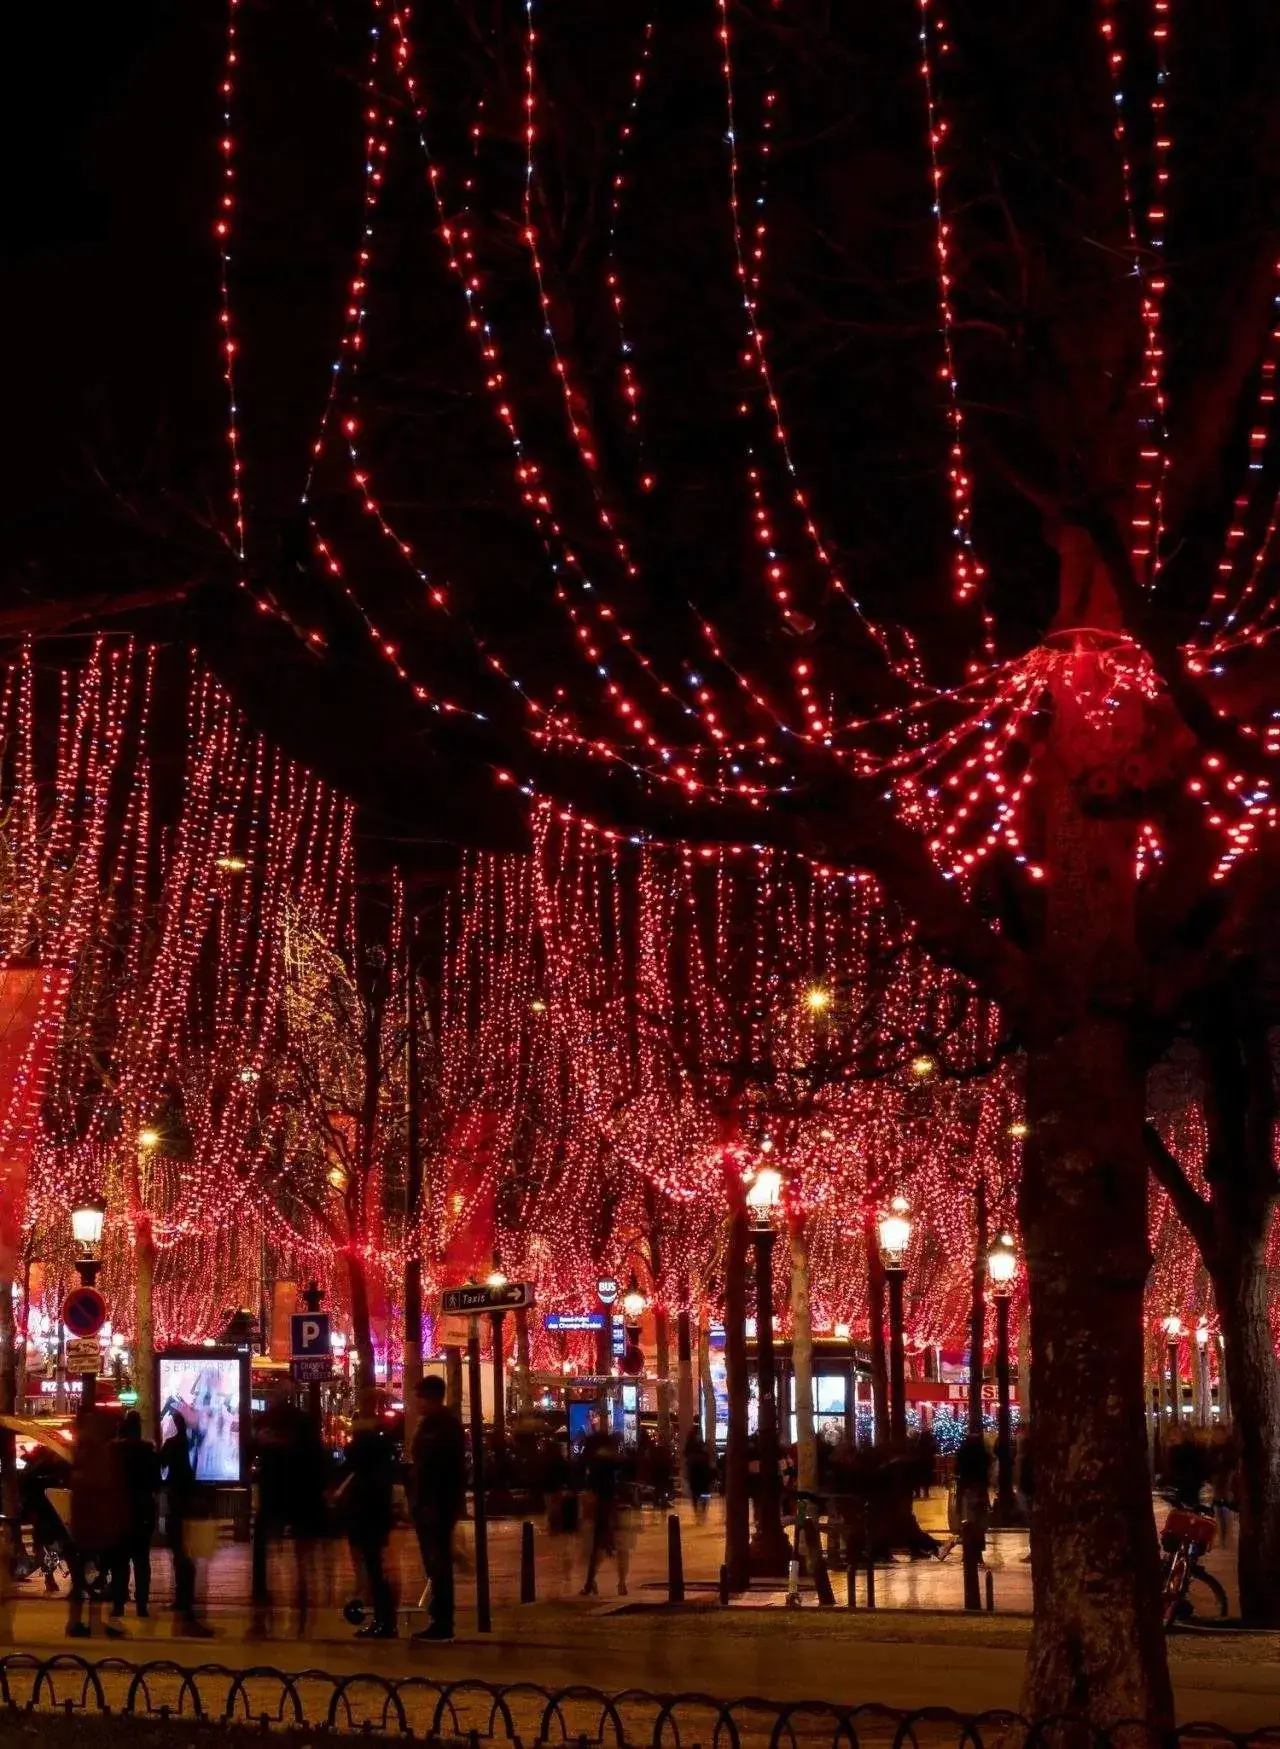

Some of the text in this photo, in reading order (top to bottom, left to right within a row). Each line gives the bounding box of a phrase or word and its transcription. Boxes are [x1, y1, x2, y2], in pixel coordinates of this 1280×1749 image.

[598, 1281, 616, 1291] BUS
[463, 1293, 485, 1304] Taxis
[302, 1321, 320, 1348] P
